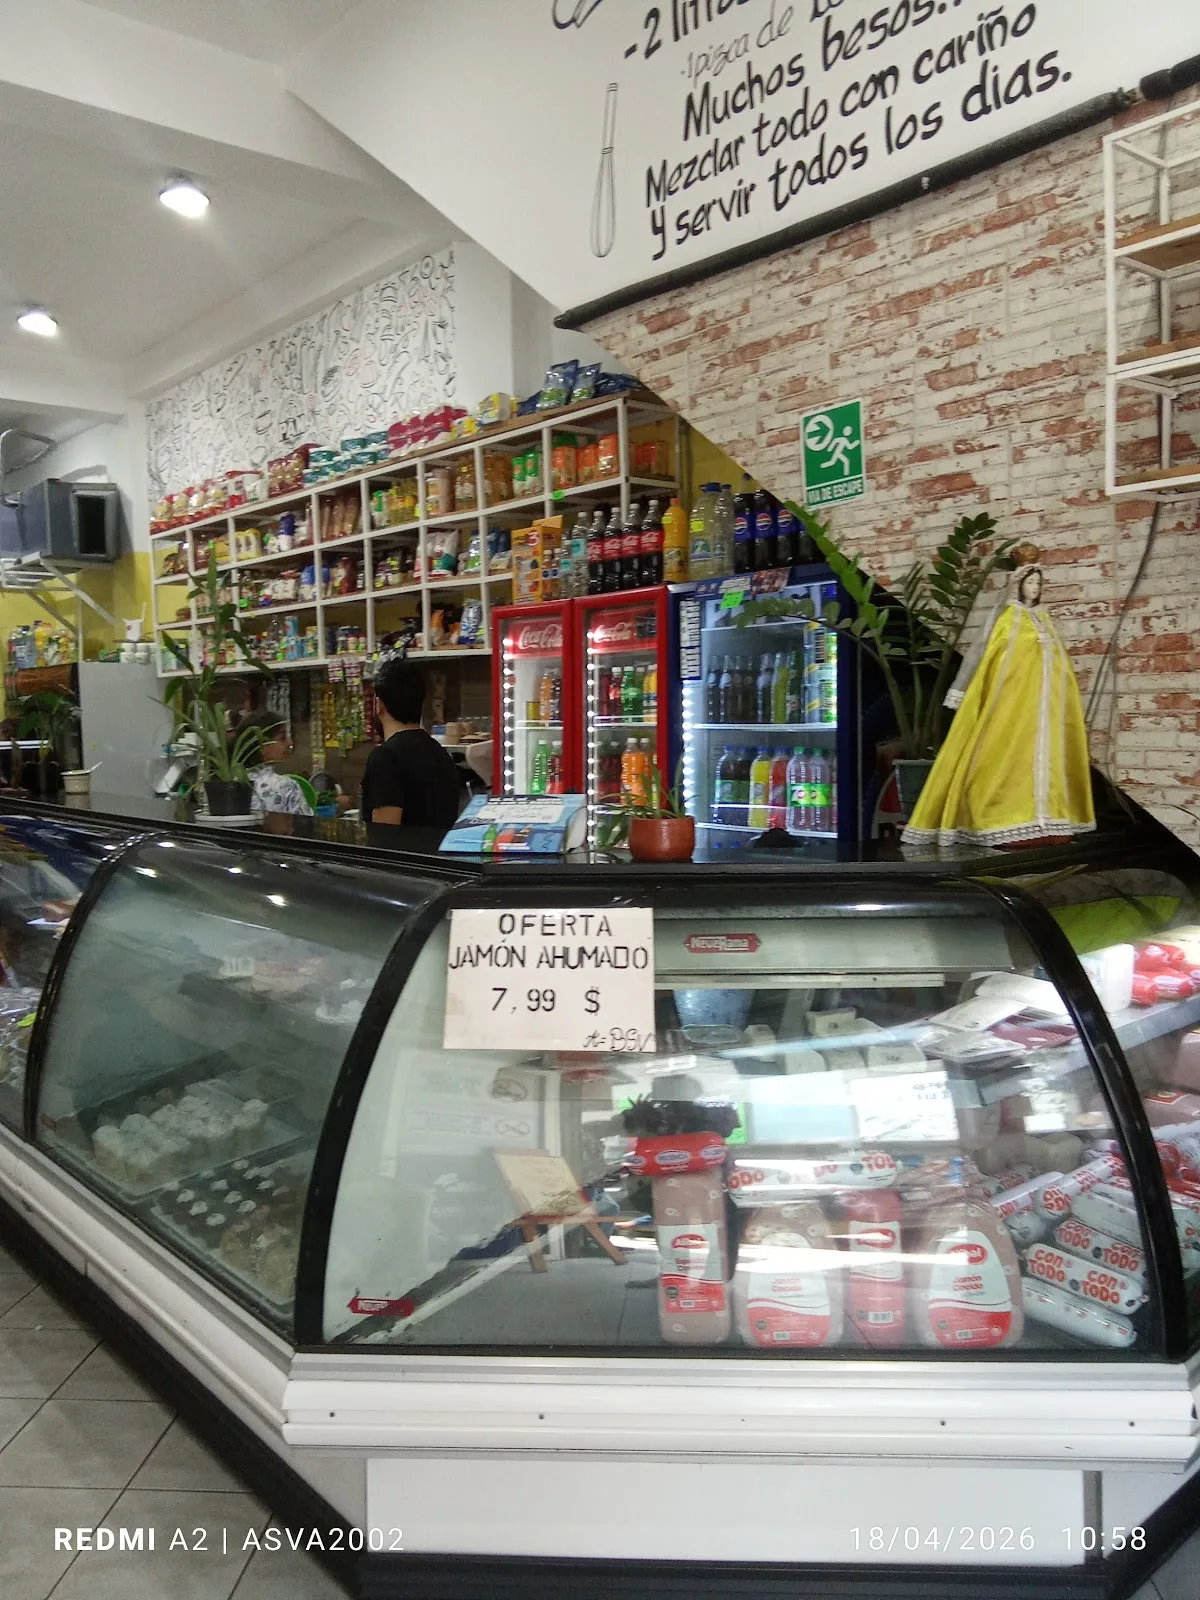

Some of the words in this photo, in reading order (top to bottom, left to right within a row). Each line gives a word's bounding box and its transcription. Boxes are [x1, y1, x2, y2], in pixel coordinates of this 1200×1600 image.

[645, 135, 746, 208] Mezclar
[752, 86, 829, 157] todo
[839, 65, 900, 117] con
[913, 3, 1037, 84] cariño
[683, 53, 805, 141] Muchos
[675, 178, 757, 246] servir
[768, 131, 868, 212] todos
[885, 101, 944, 155] los
[498, 913, 613, 937] OFERTA
[449, 938, 526, 970] JAMÓN
[536, 945, 648, 970] AHUMADO
[584, 985, 601, 1016] $
[1028, 1258, 1066, 1283] TODO
[1103, 1248, 1140, 1272] TODO
[1081, 1280, 1120, 1304] TODO
